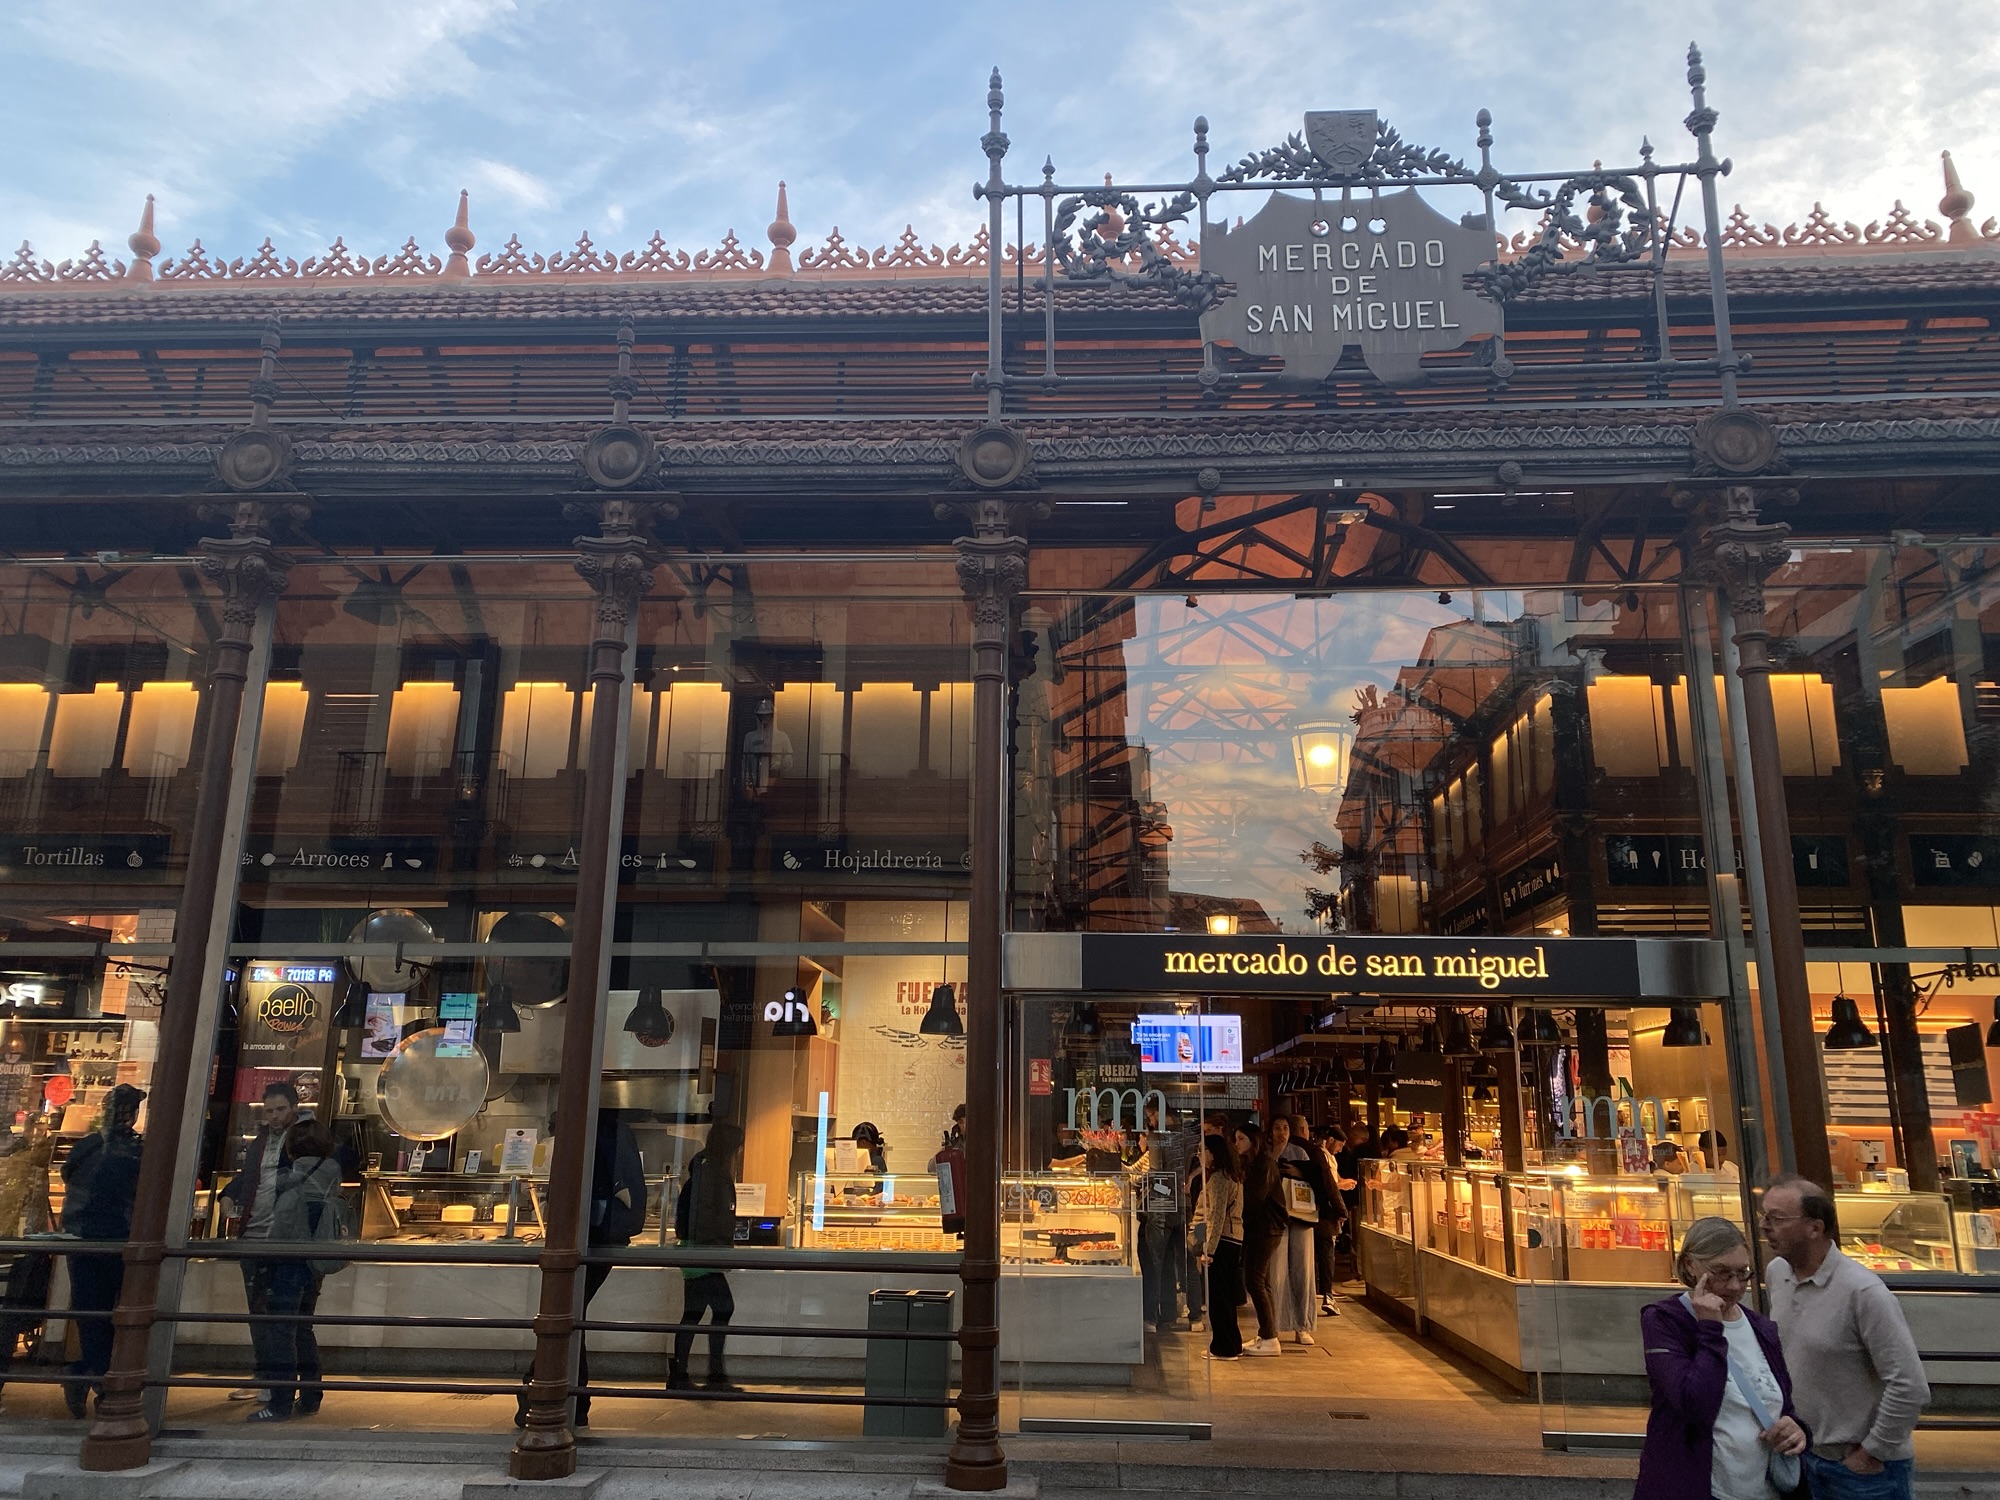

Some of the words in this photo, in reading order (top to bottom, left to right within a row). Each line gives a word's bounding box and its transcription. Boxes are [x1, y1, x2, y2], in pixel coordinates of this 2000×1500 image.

[1257, 239, 1445, 272] MERCADO
[1331, 275, 1377, 295] DE
[1246, 304, 1313, 334] SAN
[22, 846, 105, 867] Tortillas
[290, 847, 370, 869] Arroces
[824, 849, 943, 874] Hojaldrería
[1164, 943, 1308, 976] mercado
[1318, 944, 1357, 976] de
[1365, 953, 1427, 977] san
[1434, 946, 1549, 989] miguel
[257, 992, 316, 1022] paella
[276, 1042, 285, 1051] de
[1099, 1064, 1138, 1077] FUERZA
[1398, 1077, 1442, 1087] madreamiga
